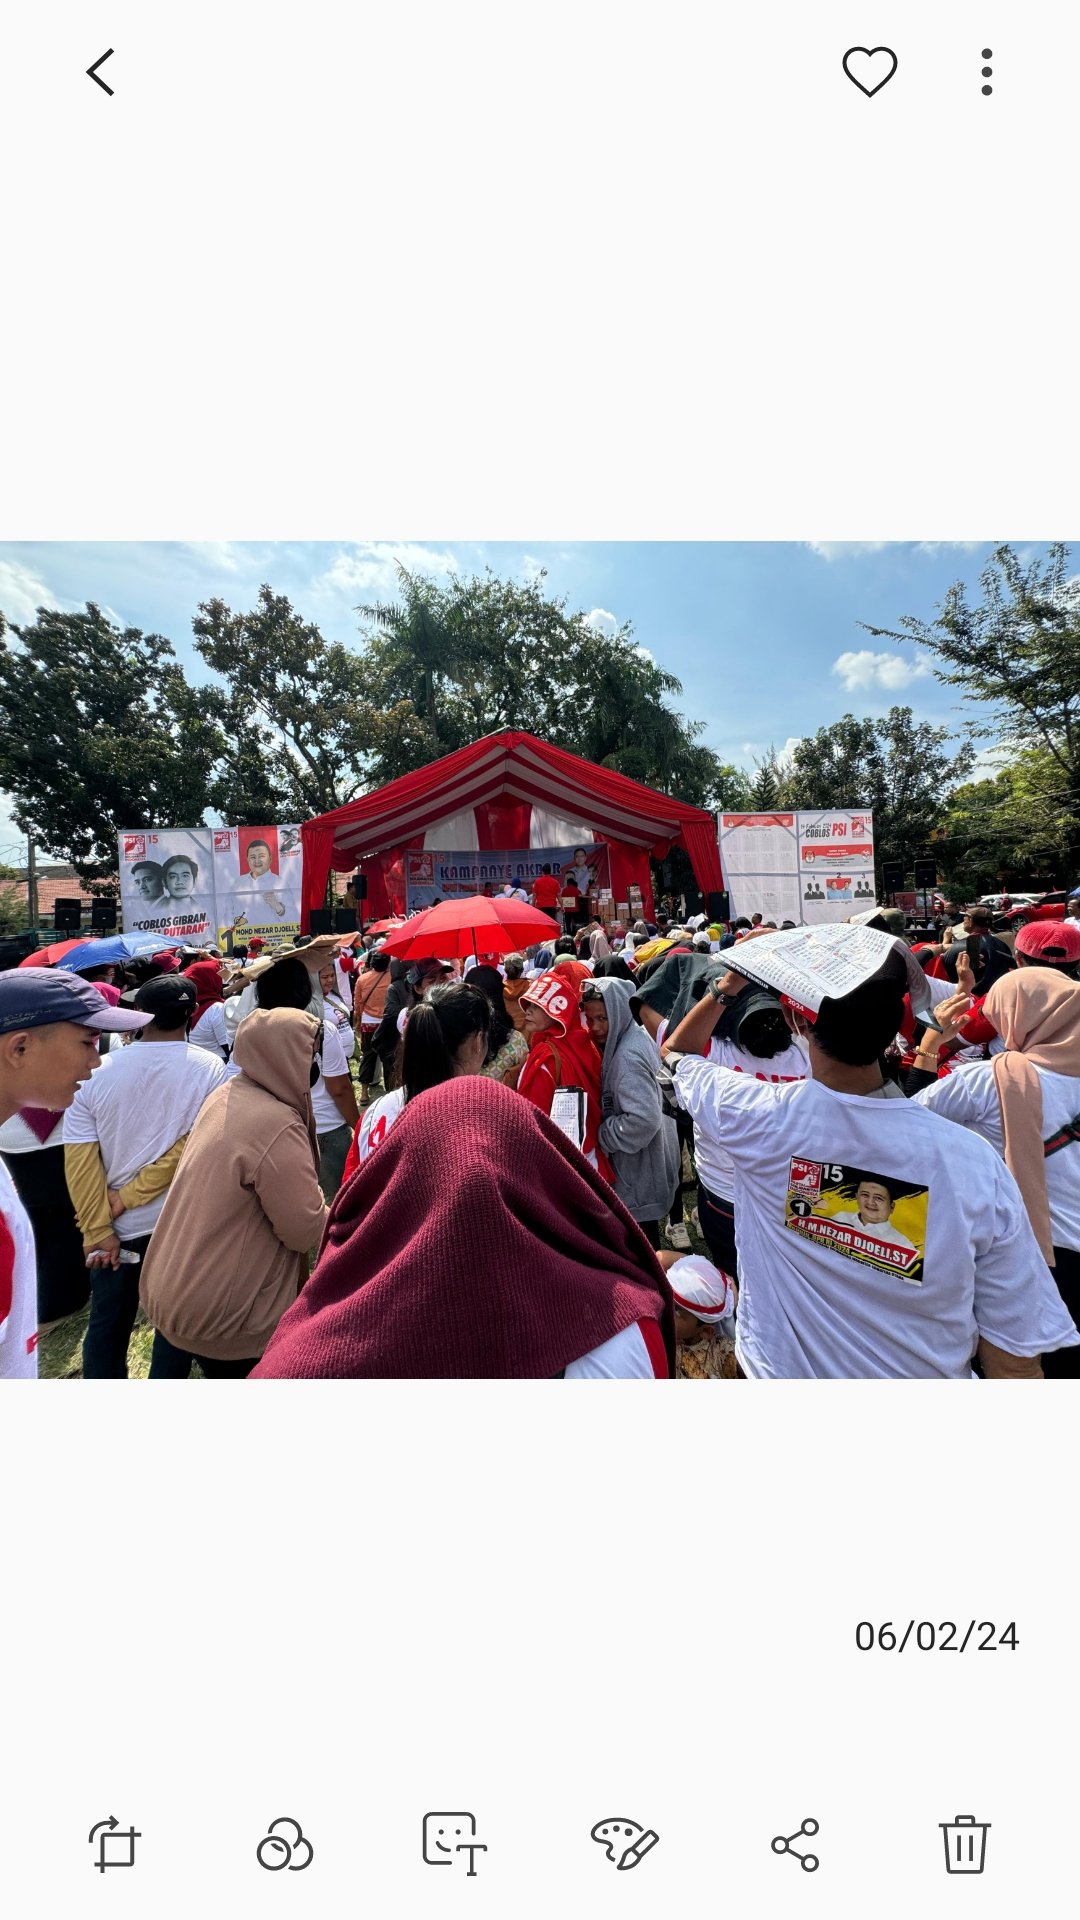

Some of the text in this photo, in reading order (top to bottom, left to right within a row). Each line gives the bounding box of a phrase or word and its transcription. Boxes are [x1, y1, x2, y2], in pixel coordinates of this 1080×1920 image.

[806, 828, 830, 838] COBLOS
[832, 823, 847, 836] PSI
[148, 835, 158, 844] 15
[434, 854, 444, 864] 15
[173, 912, 206, 927] GIBRAN
[236, 928, 252, 936] MOHD
[221, 929, 234, 957] 1
[787, 998, 804, 1012] 2024
[792, 1162, 844, 1182] PSI 15
[795, 1202, 805, 1216] 1
[833, 1242, 850, 1254] 2024
